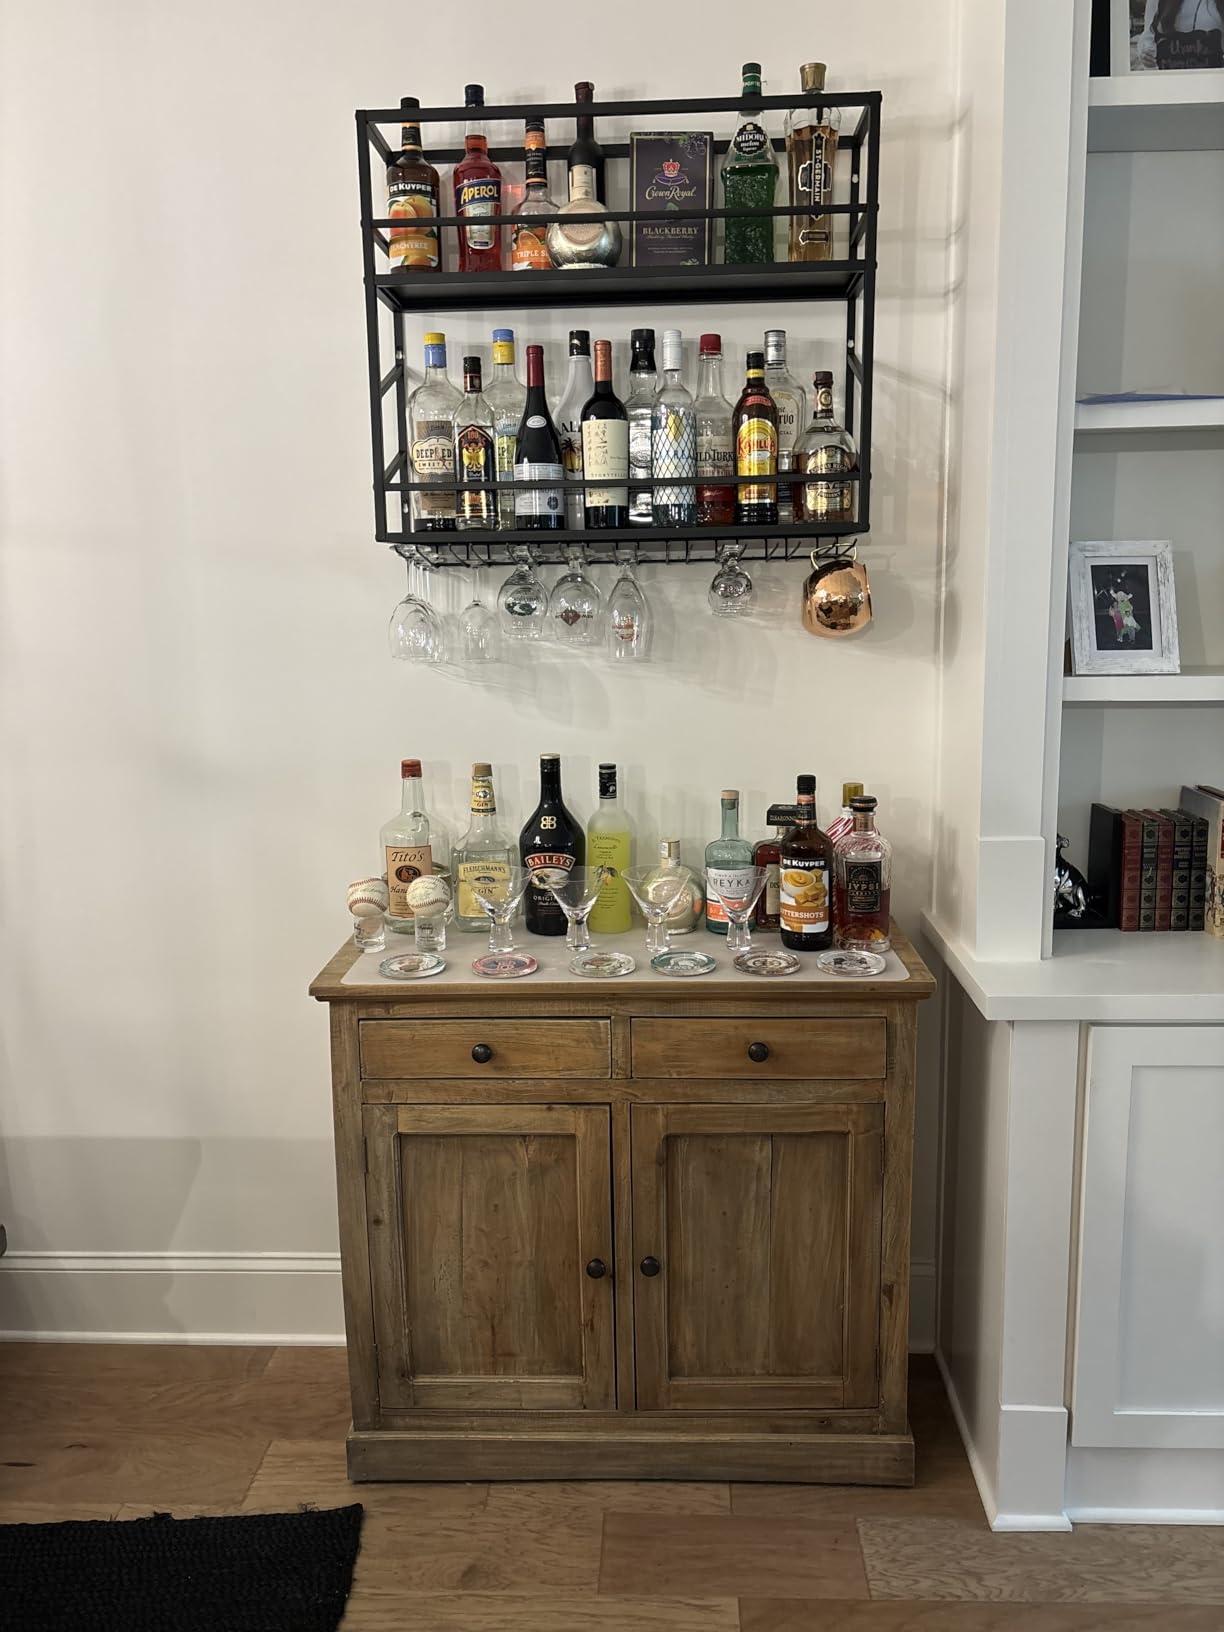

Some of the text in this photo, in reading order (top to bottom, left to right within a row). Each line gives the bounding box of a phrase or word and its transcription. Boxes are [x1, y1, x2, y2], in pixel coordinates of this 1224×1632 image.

[814, 149, 822, 202] ST-GERMAIN
[399, 182, 433, 192] KUYPER
[461, 185, 498, 205] APEROL
[645, 185, 697, 201] Crown Royal
[642, 226, 699, 235] BLACKBERRY
[516, 250, 539, 259] TRIPLE
[416, 448, 434, 459] DEEP
[391, 851, 424, 862] Tito's
[527, 855, 572, 867] BAILEYS
[792, 859, 825, 867] KUYPER
[713, 879, 750, 887] REYKA
